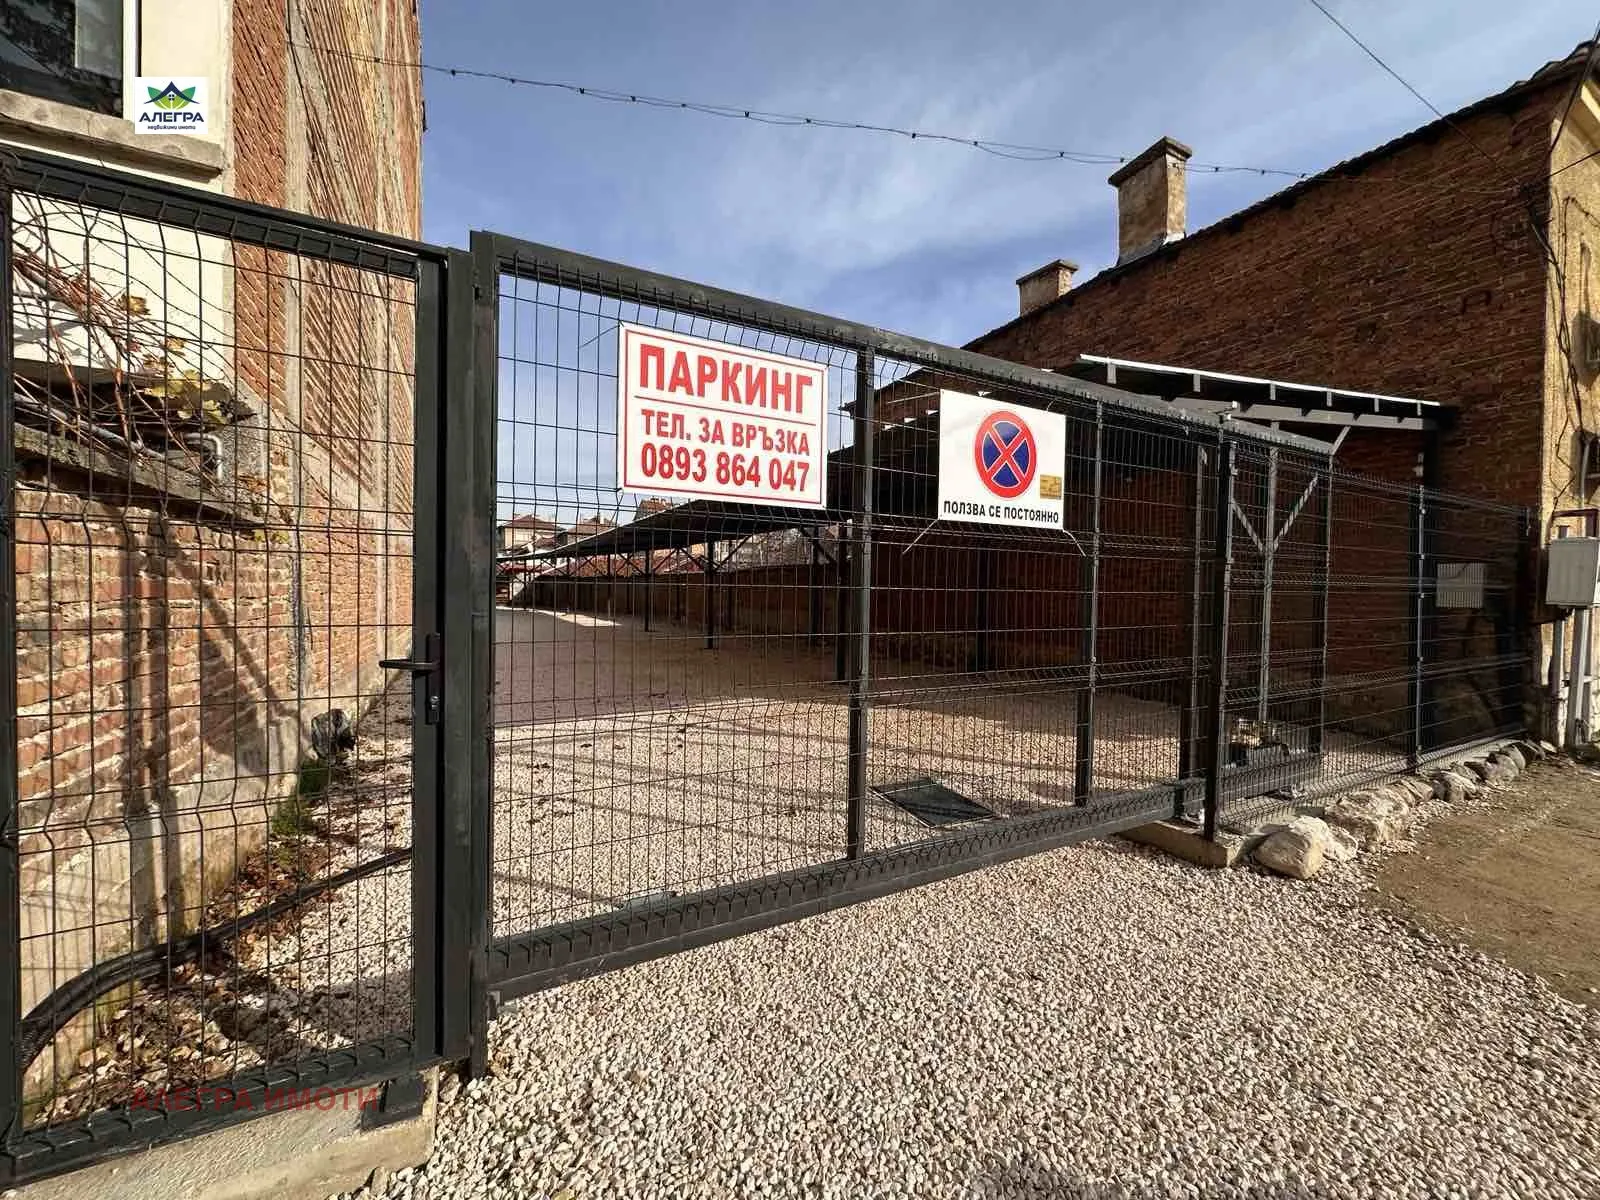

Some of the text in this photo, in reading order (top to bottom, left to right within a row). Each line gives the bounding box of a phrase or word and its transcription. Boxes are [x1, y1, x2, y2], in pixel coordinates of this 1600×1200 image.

[639, 343, 813, 413] ПАРКИНГ
[641, 408, 810, 456] ТЕЛ. ЗА ВРЪЗКА
[641, 442, 810, 492] 0893 864 047
[943, 500, 1059, 524] ПОЛЗВА СЕ ПОСТОЯННО
